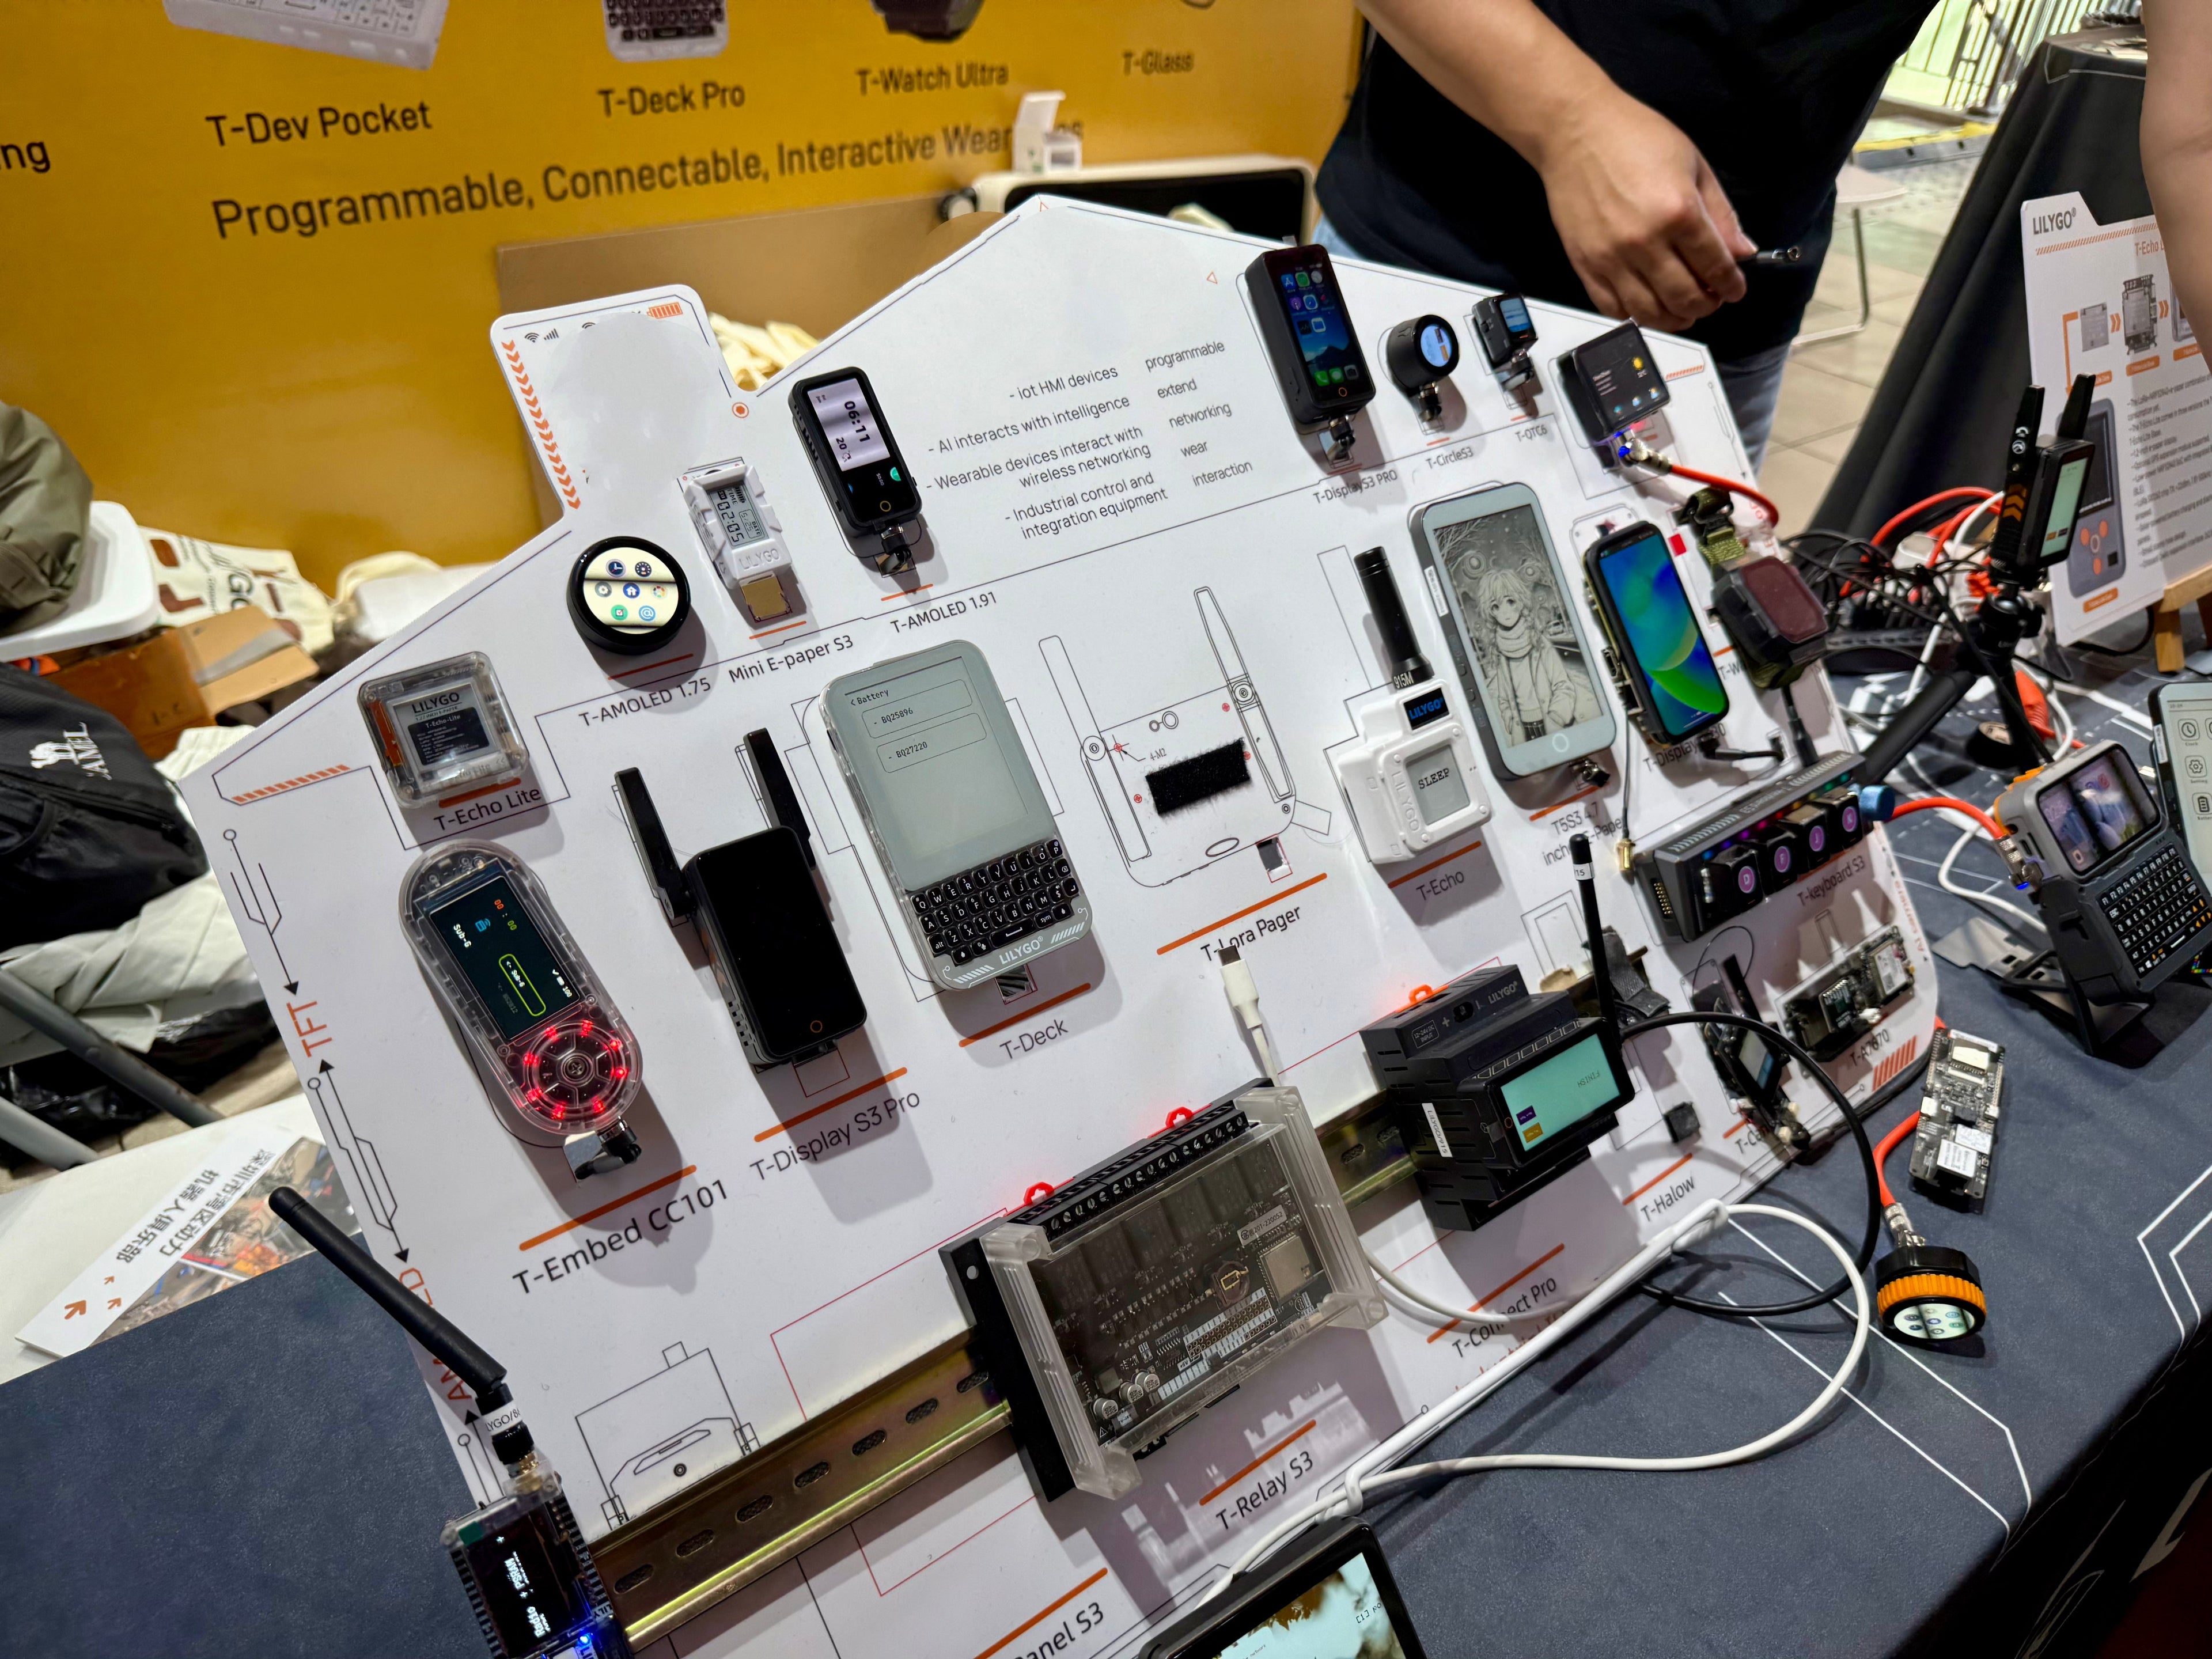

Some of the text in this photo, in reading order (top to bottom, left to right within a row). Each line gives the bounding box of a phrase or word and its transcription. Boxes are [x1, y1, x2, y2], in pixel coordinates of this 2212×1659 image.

[856, 62, 1009, 96] T-Watch Ultra
[1122, 51, 1194, 75] T-Glass
[599, 82, 745, 118] T-Deck Pro
[206, 101, 433, 146] T-Dev Pocket
[212, 172, 535, 238] Programmable,
[543, 145, 770, 202] Connectable,
[777, 129, 935, 177] Interactive
[2135, 240, 2159, 257] T-Echo
[1145, 340, 1225, 373] programmable
[1039, 377, 1066, 396] HMI
[1068, 365, 1119, 390] devices
[1157, 378, 1198, 400] extend
[844, 400, 871, 443] 06:11
[938, 395, 1130, 454] AI interacts with intelligence
[1169, 402, 1233, 430] networking
[933, 425, 1145, 491] Wearable devices interact with
[1020, 442, 1152, 490] wireless networking
[1180, 440, 1209, 458] wear
[1427, 446, 1474, 470] T-CircleS3
[1192, 460, 1254, 488] interaction
[1313, 469, 1399, 505] T-DisplayS3 PRO
[726, 488, 738, 505] TIME
[1013, 472, 1155, 522] Industrial control and
[1021, 488, 1169, 540] integration equipment
[717, 501, 745, 543] 02:05
[738, 547, 781, 570] LILYGO
[889, 591, 998, 635] T-AMOLED 1.91
[729, 634, 855, 684] Mini E-paper S3
[857, 688, 889, 706] Battery
[1393, 671, 1414, 690] 915M
[412, 692, 460, 714] LILYGO
[578, 677, 712, 728] T-AMOLED 1.75
[881, 707, 914, 725] BQ25896
[895, 741, 928, 759] BQ27220
[1418, 767, 1450, 790] SLEEP
[434, 788, 541, 831] T-Echo Lite
[1391, 771, 1420, 832] LILYGO
[1551, 813, 1583, 835] T5S3
[1415, 870, 1465, 902] T-Echo
[1797, 854, 1866, 907] T-keyboard S3
[1040, 914, 1051, 923] sym
[1255, 905, 1301, 941] Pager
[286, 1001, 333, 1058] TFT
[999, 1019, 1069, 1059] T-Deck
[749, 1091, 921, 1182] T-Display S3 Pro
[115, 1169, 220, 1264] 机器人俱乐部
[1641, 1175, 1696, 1223] T-Halow
[512, 1179, 729, 1296] T-Embed CC101
[1529, 1276, 1557, 1308] Pro
[1215, 1450, 1316, 1532] T-Relay S3
[1077, 1601, 1105, 1635] S3
